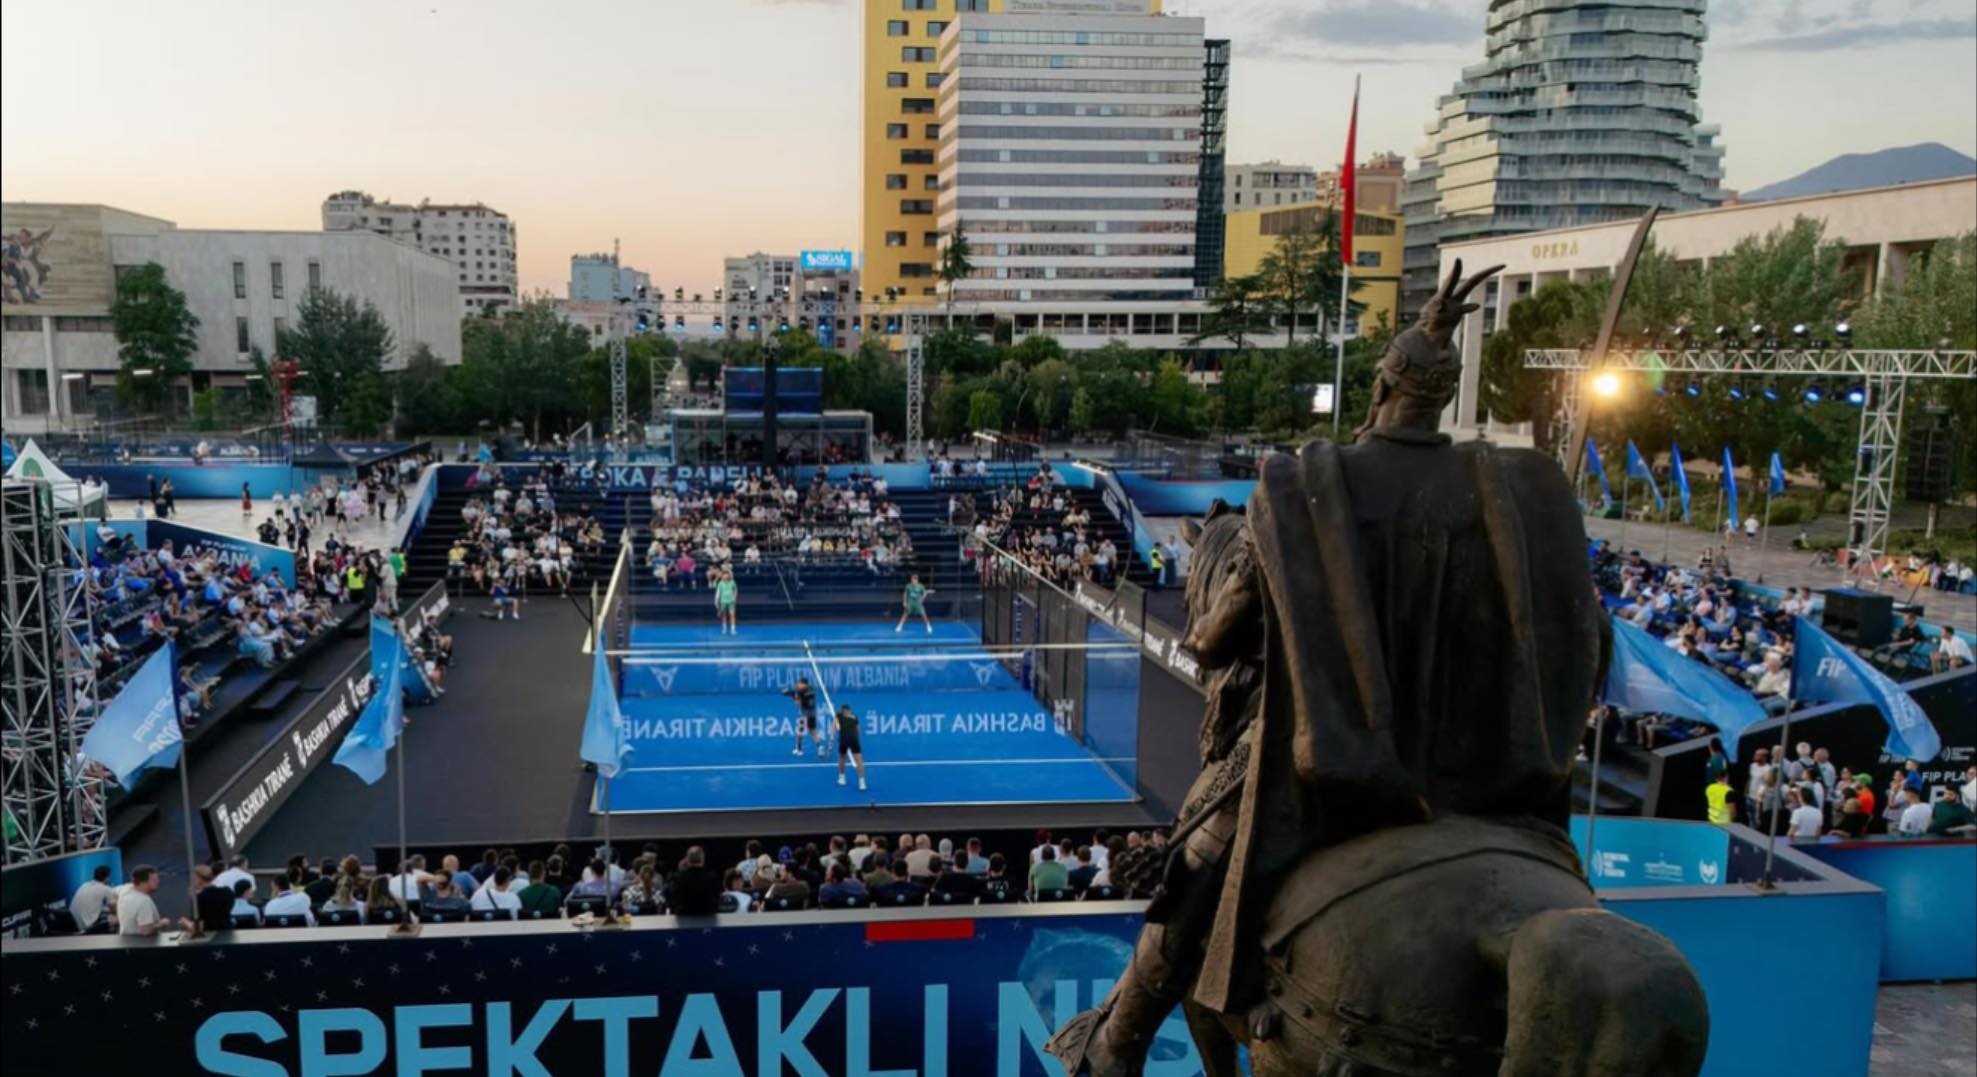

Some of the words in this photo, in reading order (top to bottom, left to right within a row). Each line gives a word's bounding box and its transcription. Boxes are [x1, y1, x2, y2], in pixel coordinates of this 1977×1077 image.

[739, 667, 763, 689] FIP
[845, 664, 910, 687] ALBANIA
[195, 984, 949, 1077] SPEKTAKLI
